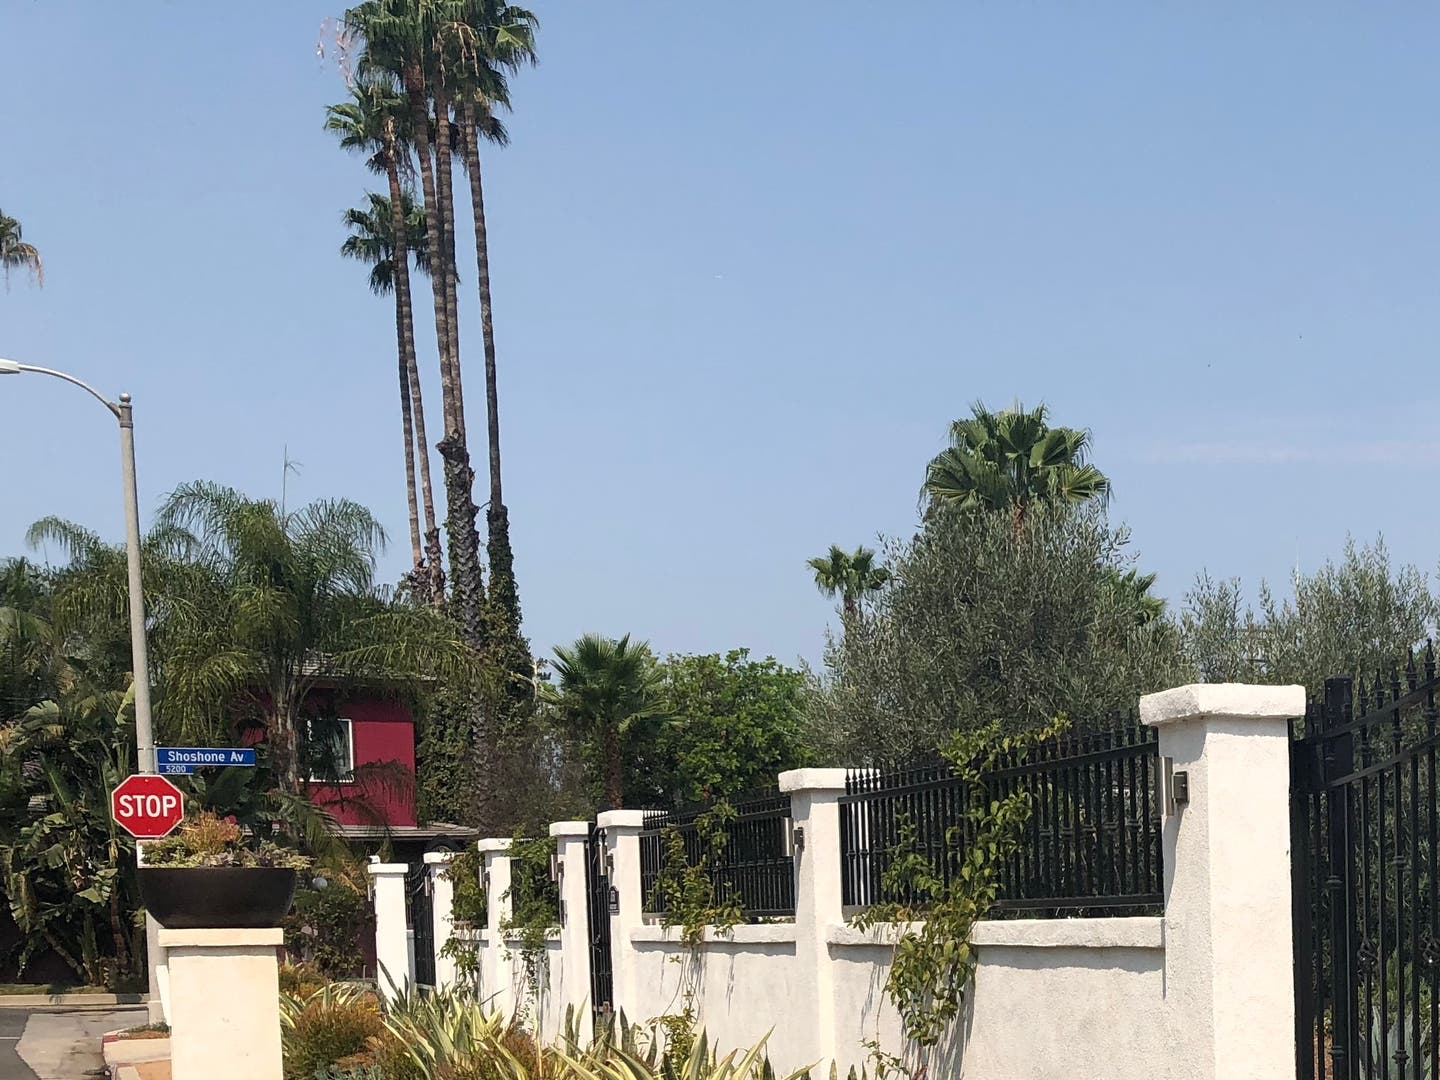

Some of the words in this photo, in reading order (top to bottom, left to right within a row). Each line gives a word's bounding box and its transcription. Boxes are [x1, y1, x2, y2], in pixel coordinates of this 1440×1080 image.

[167, 751, 225, 762] Shoshone
[230, 751, 244, 762] Av
[166, 765, 186, 773] 5200
[119, 794, 177, 818] STOP
